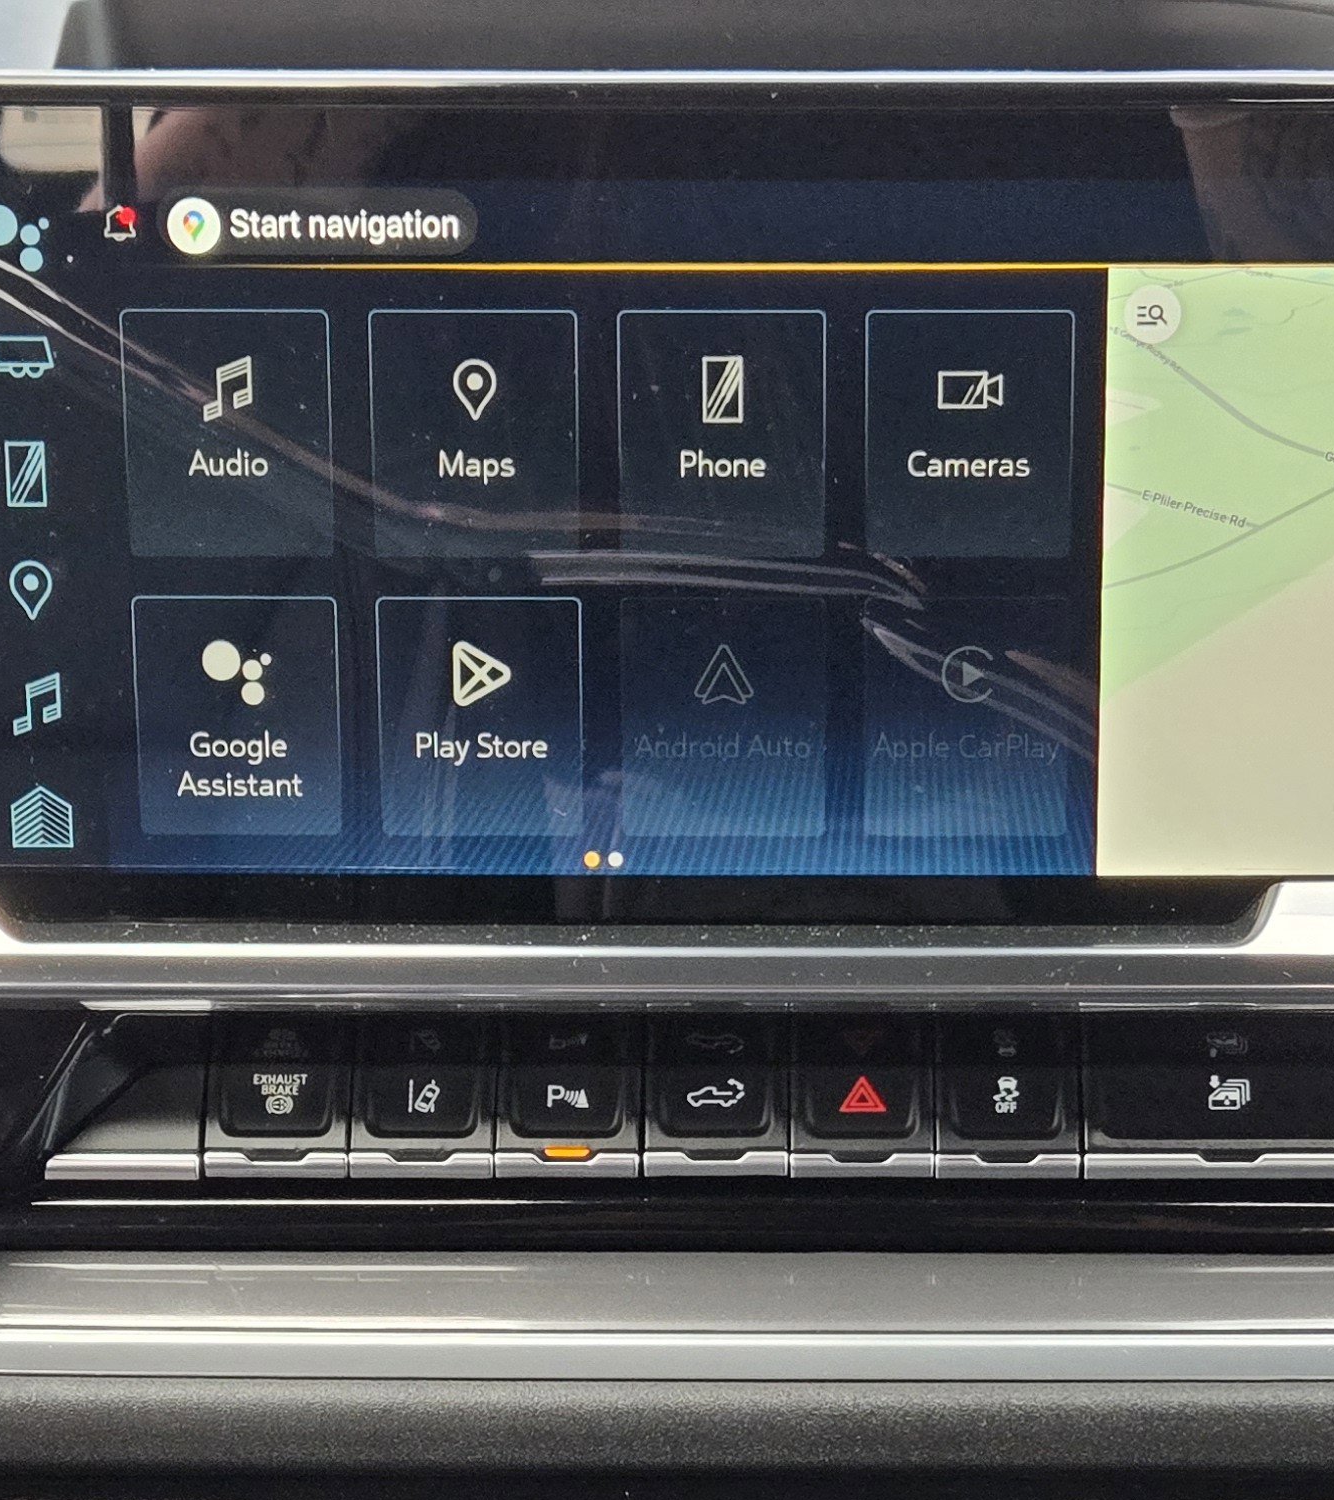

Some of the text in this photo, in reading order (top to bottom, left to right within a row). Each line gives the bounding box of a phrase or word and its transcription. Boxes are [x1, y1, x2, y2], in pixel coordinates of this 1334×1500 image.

[229, 208, 460, 249] Start navigation
[188, 450, 269, 478] Audio
[438, 450, 516, 488] Maps
[679, 450, 766, 479] Phone
[906, 450, 1031, 478] Cameras
[1142, 489, 1151, 501] E
[1183, 501, 1228, 524] Precise
[1229, 514, 1247, 528] Rd
[190, 732, 288, 766] Google
[414, 733, 549, 766] Play Store
[635, 732, 811, 760] Android Auto
[873, 733, 1059, 765] Apple CarPlay
[176, 772, 304, 799] Assistant
[252, 1073, 308, 1086] EXHAUST
[260, 1084, 299, 1096] BRAKE
[994, 1101, 1017, 1113] OFF
